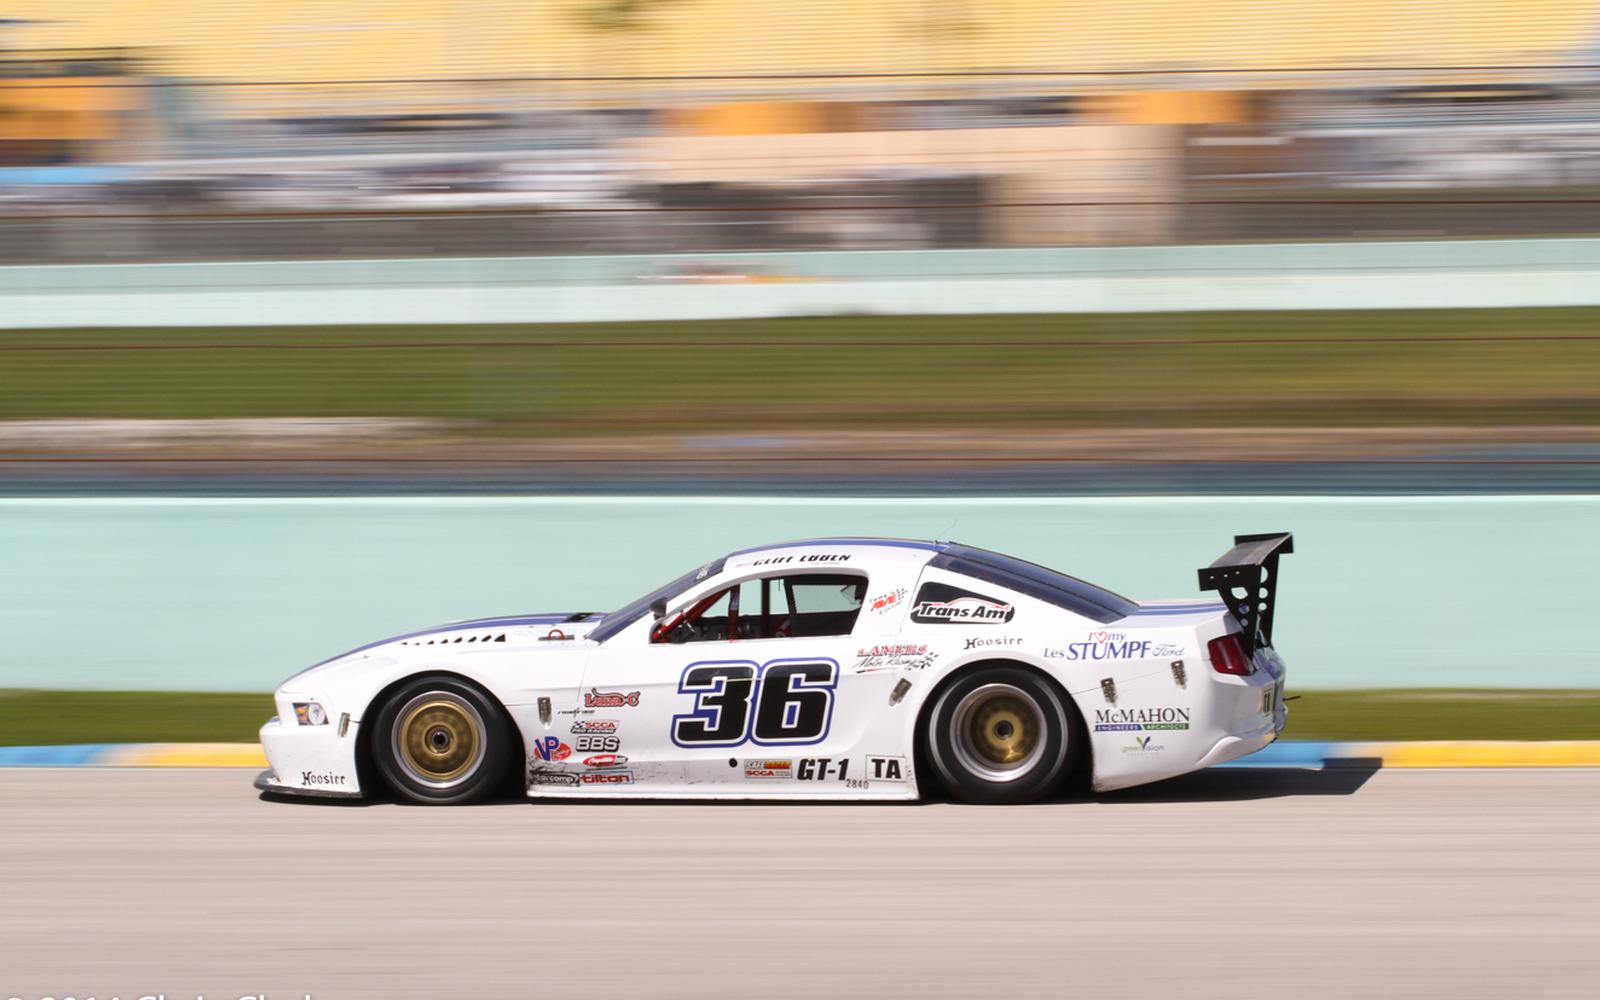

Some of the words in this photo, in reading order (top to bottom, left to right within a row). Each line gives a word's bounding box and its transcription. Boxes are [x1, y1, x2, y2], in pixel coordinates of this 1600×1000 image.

[919, 602, 969, 617] Trans
[971, 605, 1006, 618] Am
[963, 636, 1023, 650] Hoosier
[1088, 632, 1093, 641] I
[1108, 632, 1127, 643] my
[1044, 647, 1066, 658] Les
[1066, 640, 1152, 660] STUMPF
[1152, 644, 1185, 657] Ford
[670, 656, 840, 749] 36
[1095, 708, 1190, 723] McMAHON
[585, 721, 616, 729] SCCA
[534, 736, 560, 761] VP
[576, 736, 620, 752] BBS
[797, 758, 850, 781] GT-1
[871, 758, 902, 779] TA
[301, 771, 346, 785] Hoosier
[581, 774, 630, 783] tilton
[846, 778, 869, 789] 2840
